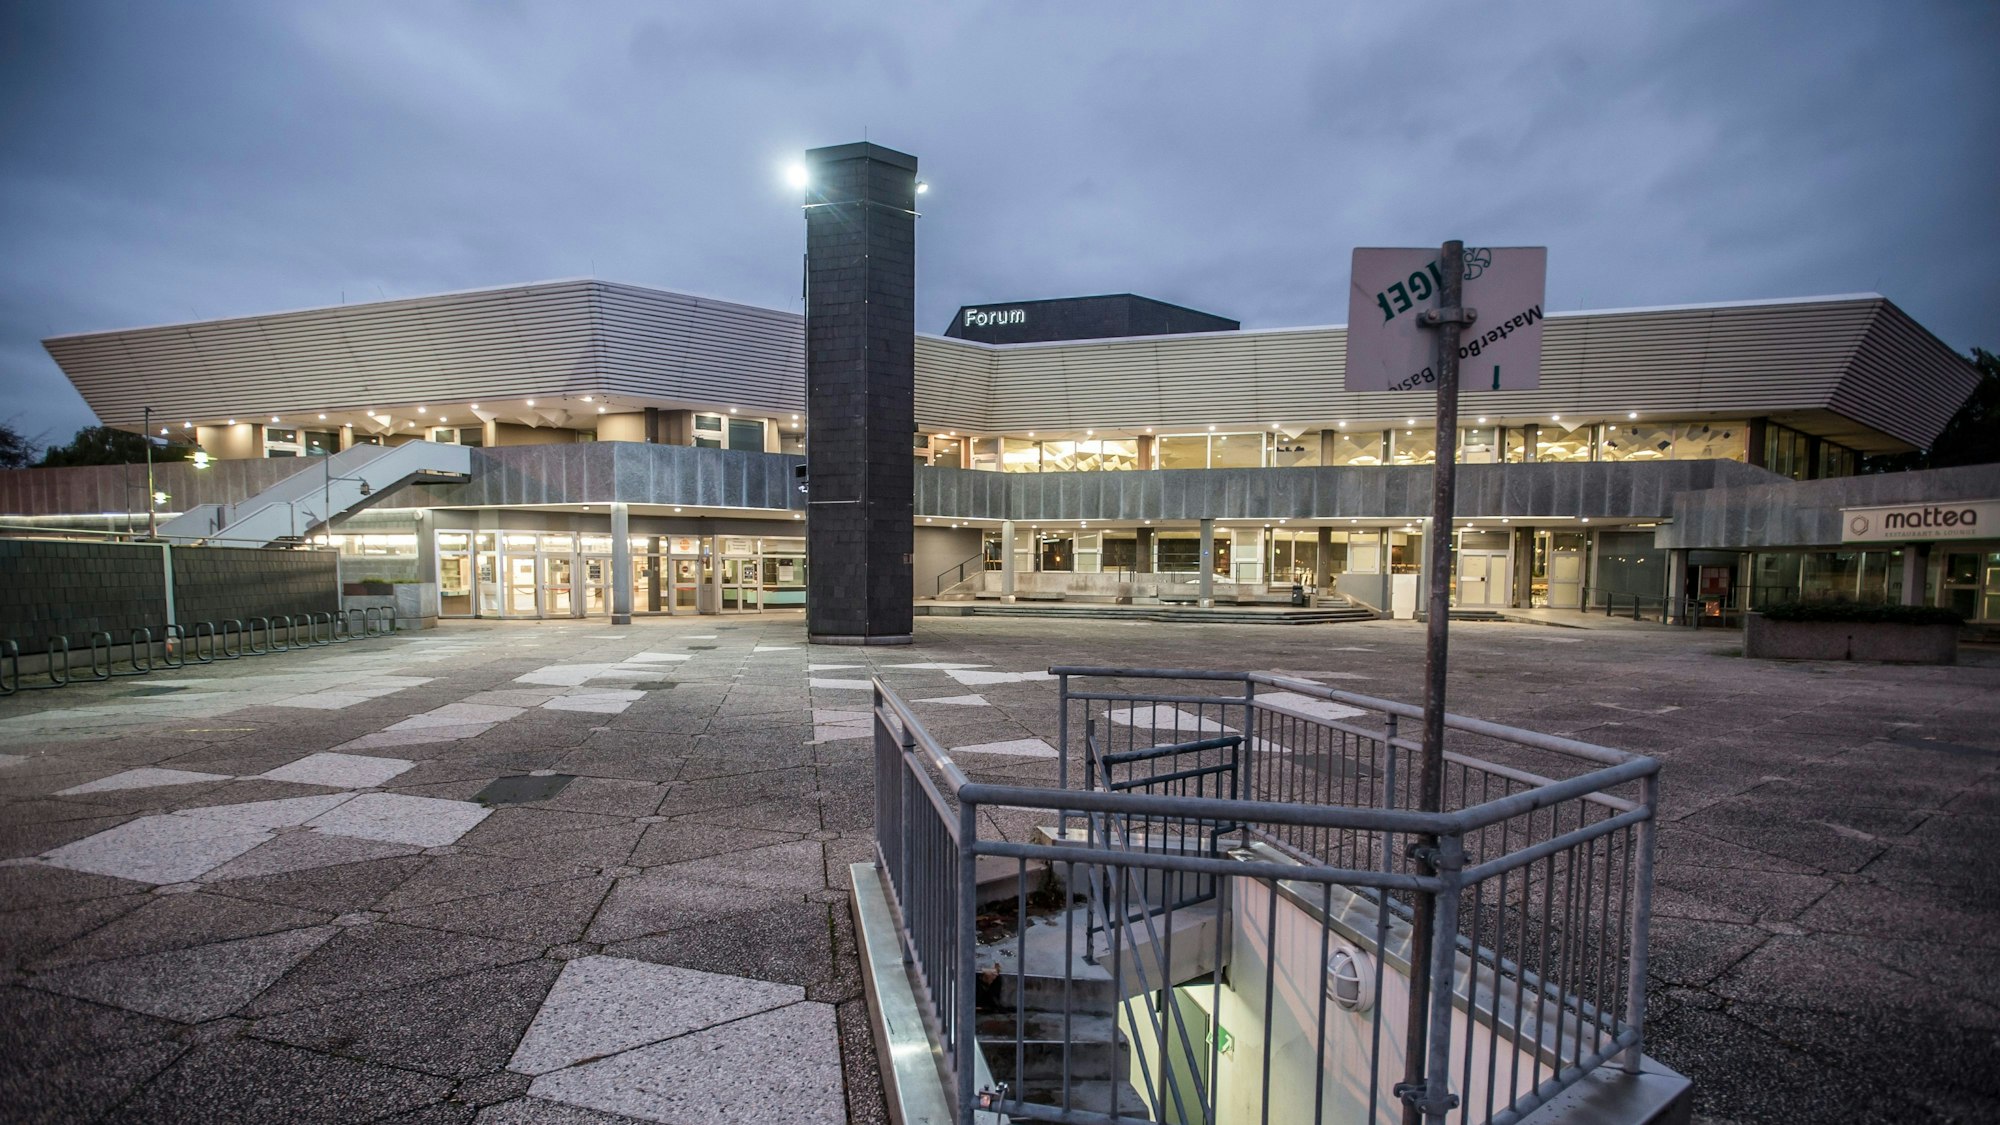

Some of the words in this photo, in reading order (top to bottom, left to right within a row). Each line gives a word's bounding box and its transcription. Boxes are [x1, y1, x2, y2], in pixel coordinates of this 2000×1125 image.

[964, 308, 1025, 327] Forum
[1459, 304, 1543, 359] MasterBo
[1885, 507, 1977, 529] mattea
